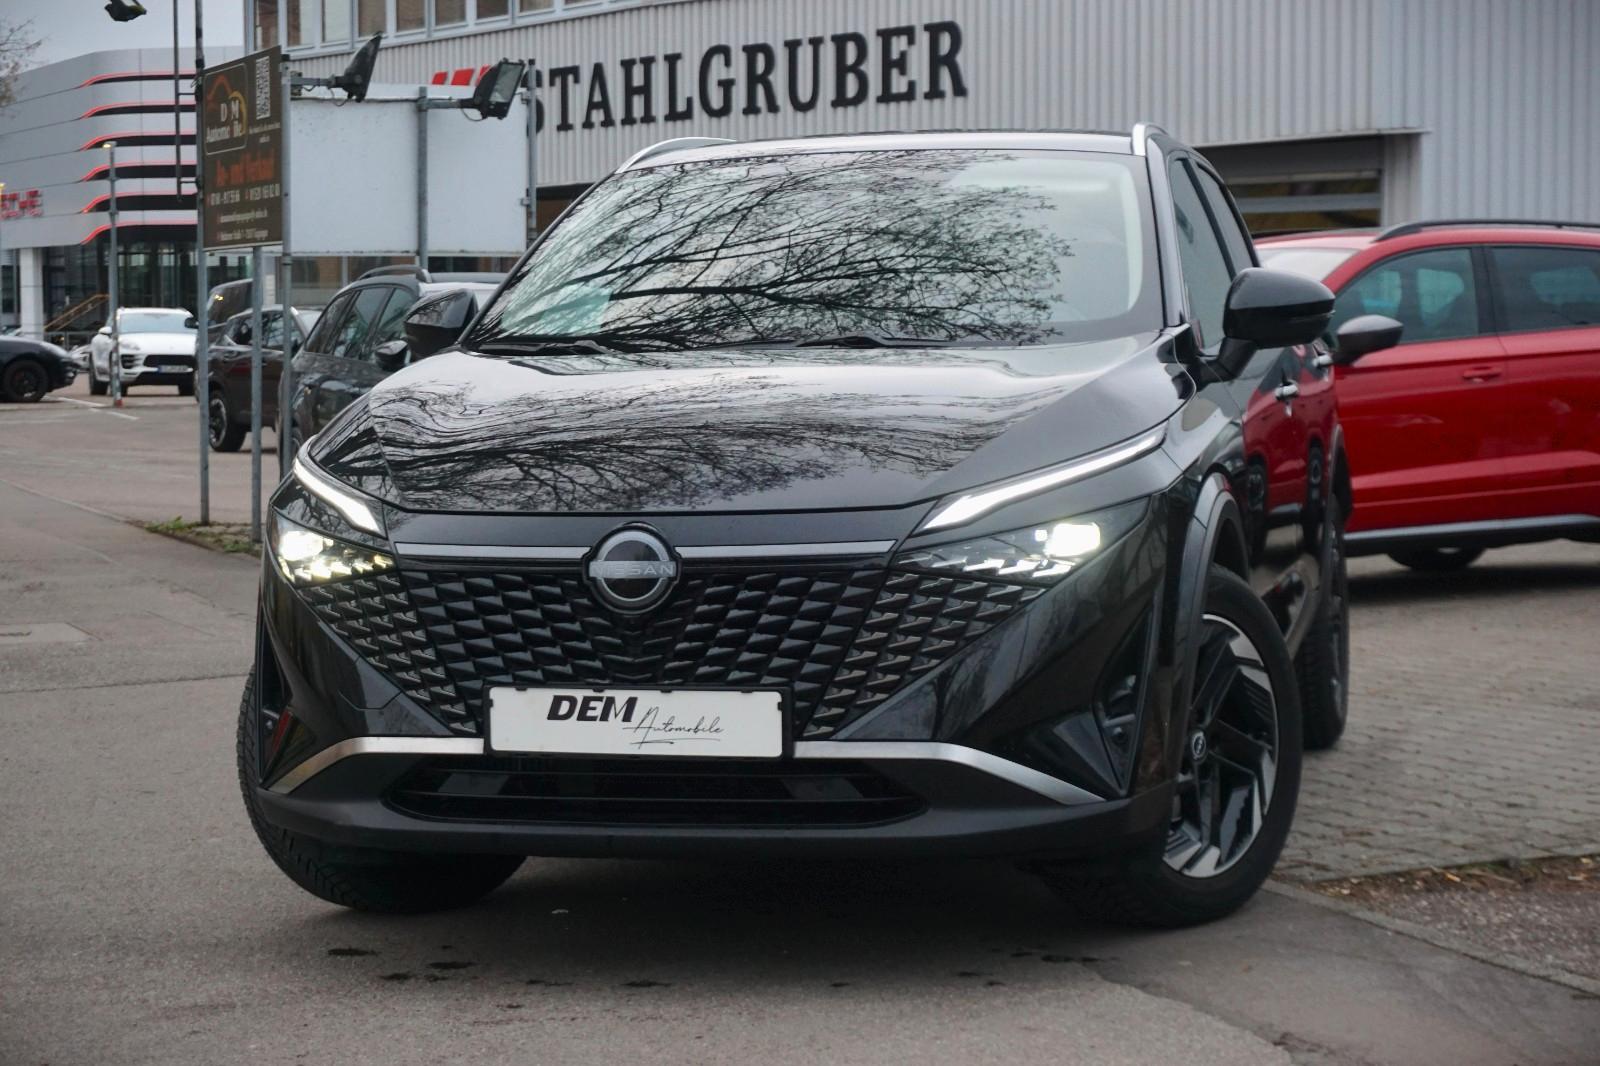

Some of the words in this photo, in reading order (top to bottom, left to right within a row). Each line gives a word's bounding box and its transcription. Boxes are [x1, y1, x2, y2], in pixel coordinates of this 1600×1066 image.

[520, 20, 968, 137] STAHLGRUBER
[547, 694, 639, 723] DEM
[622, 706, 725, 750] Automobile
